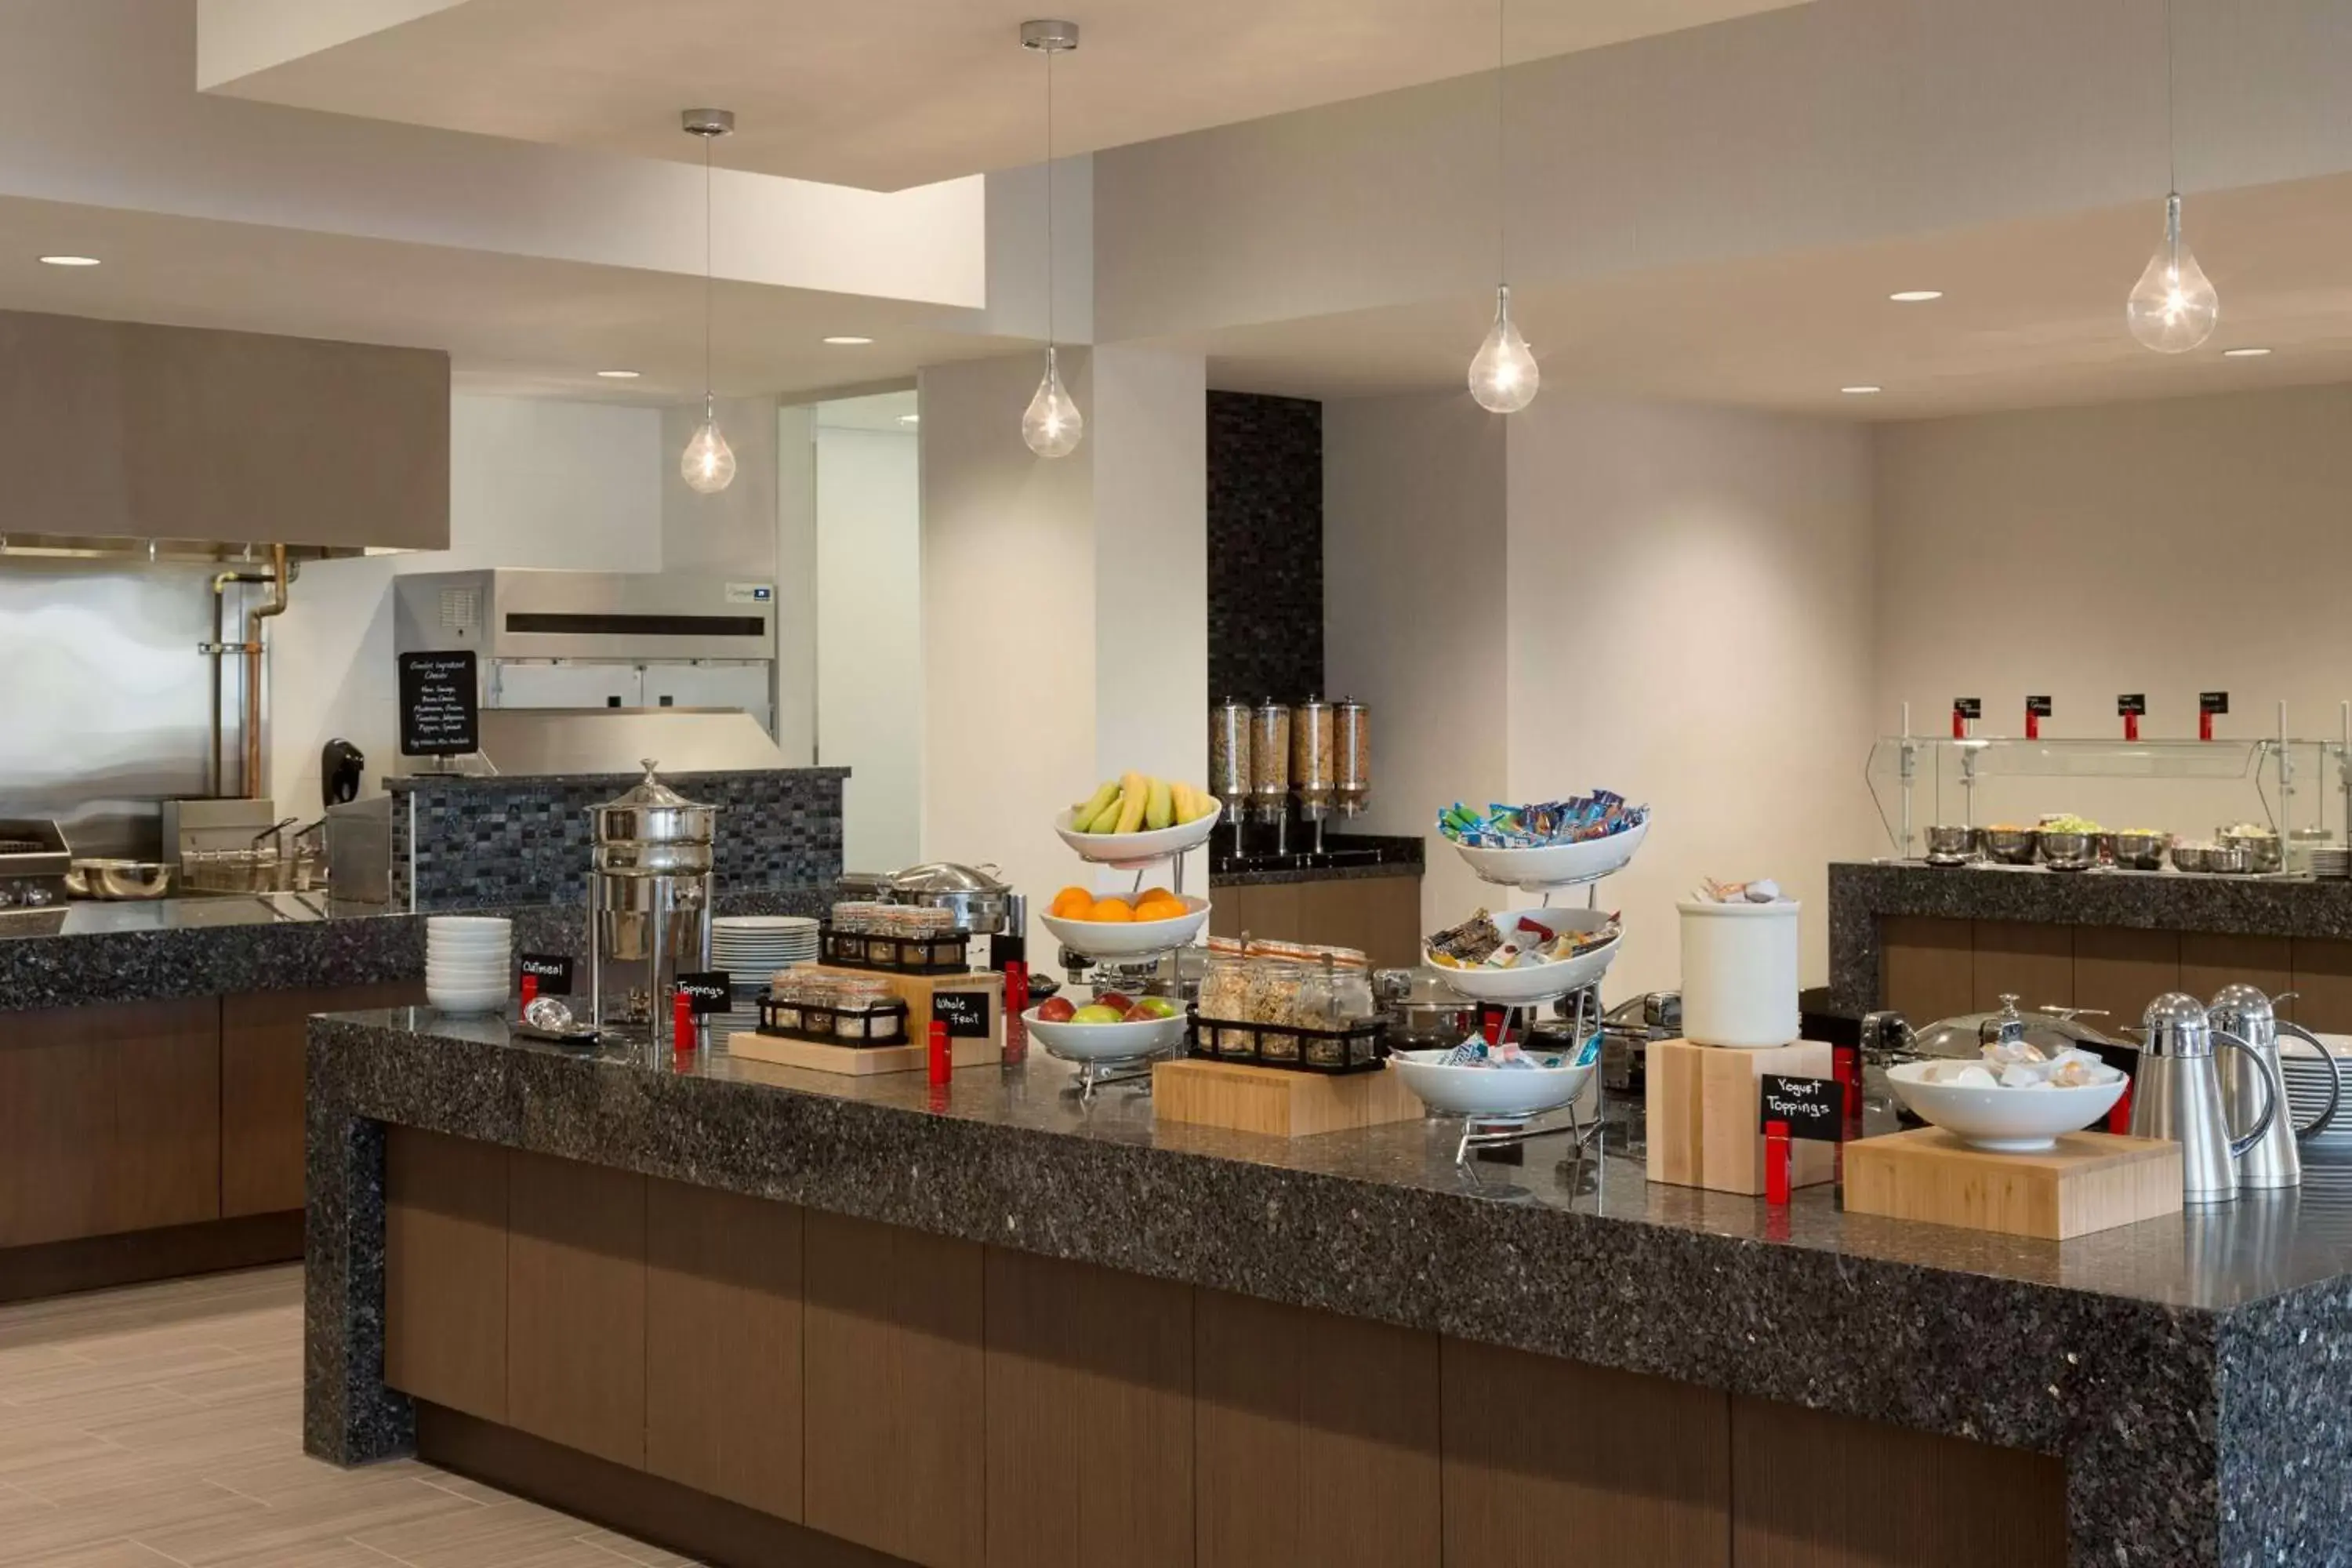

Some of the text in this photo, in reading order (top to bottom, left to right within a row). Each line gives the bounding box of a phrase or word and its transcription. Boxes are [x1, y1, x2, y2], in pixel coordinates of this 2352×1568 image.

[677, 981, 724, 999] Toppings
[935, 996, 966, 1011] Whole
[1766, 1095, 1831, 1117] Toppings
